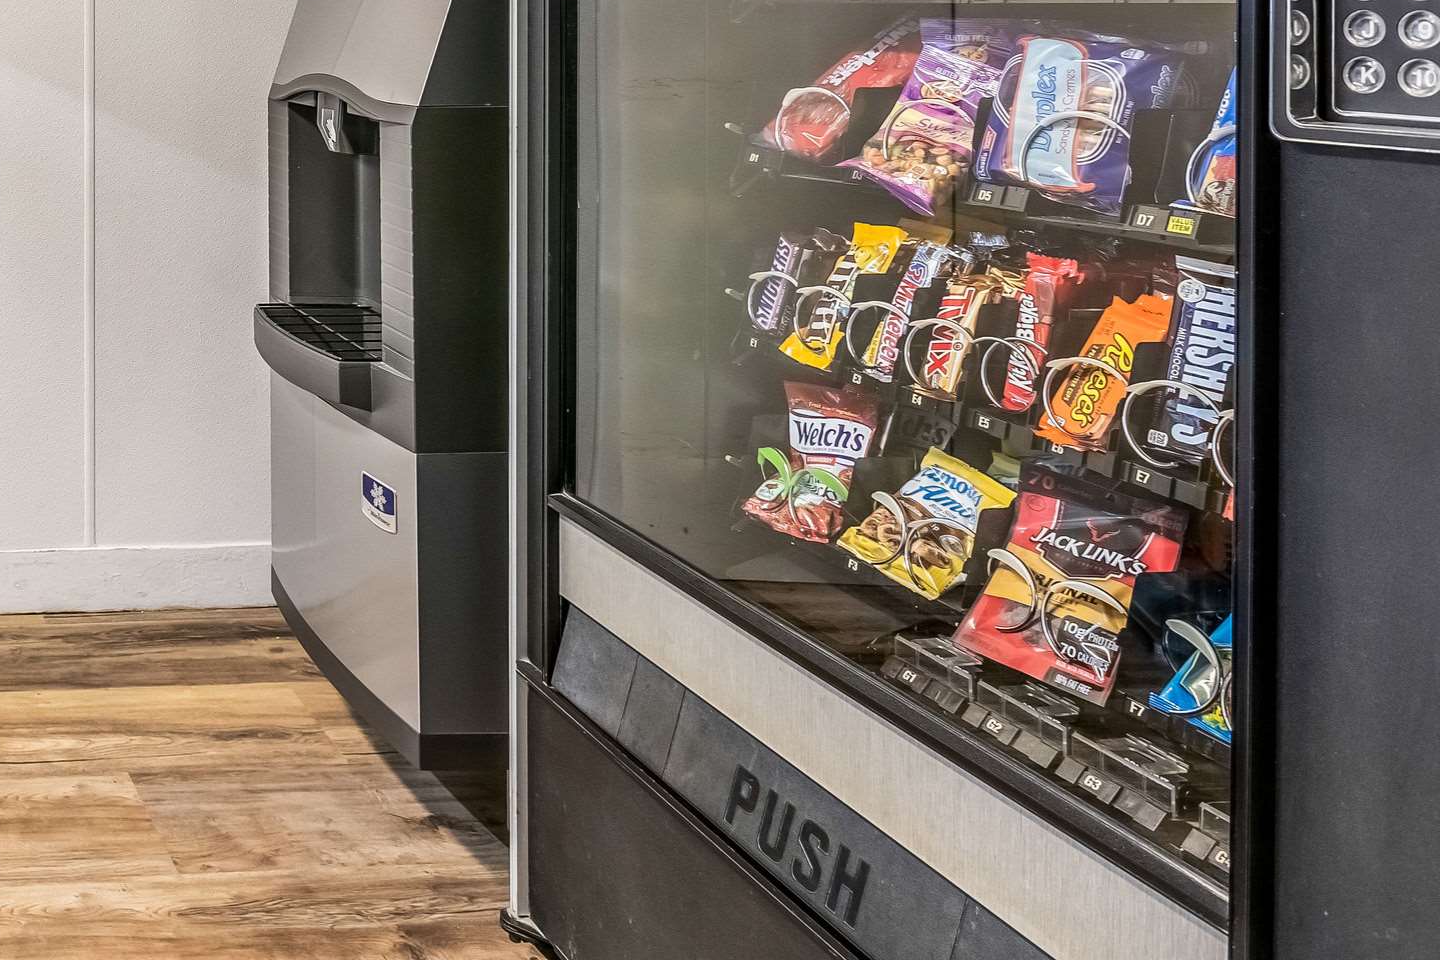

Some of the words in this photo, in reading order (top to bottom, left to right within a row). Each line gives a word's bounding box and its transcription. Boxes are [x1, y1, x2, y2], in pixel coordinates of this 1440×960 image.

[749, 153, 759, 163] D1
[852, 170, 863, 181] D3
[978, 190, 992, 201] D5
[1136, 213, 1154, 227] D7
[1170, 217, 1195, 227] VALUE
[1171, 223, 1192, 233] ITEM
[1177, 327, 1186, 346] MILK
[750, 338, 758, 348] E1
[852, 374, 862, 385] E3
[912, 394, 922, 405] E4
[978, 416, 990, 428] E5
[793, 420, 865, 452] Welch's
[1135, 472, 1150, 484] E7
[1031, 526, 1086, 558] JACK
[1082, 545, 1147, 576] LINK'S
[848, 560, 858, 571] F3
[1060, 642, 1077, 660] 70
[902, 670, 916, 682] G1
[1129, 701, 1145, 717] F7
[986, 719, 1002, 733] G2
[1084, 776, 1101, 791] G3
[722, 764, 871, 930] PUSH
